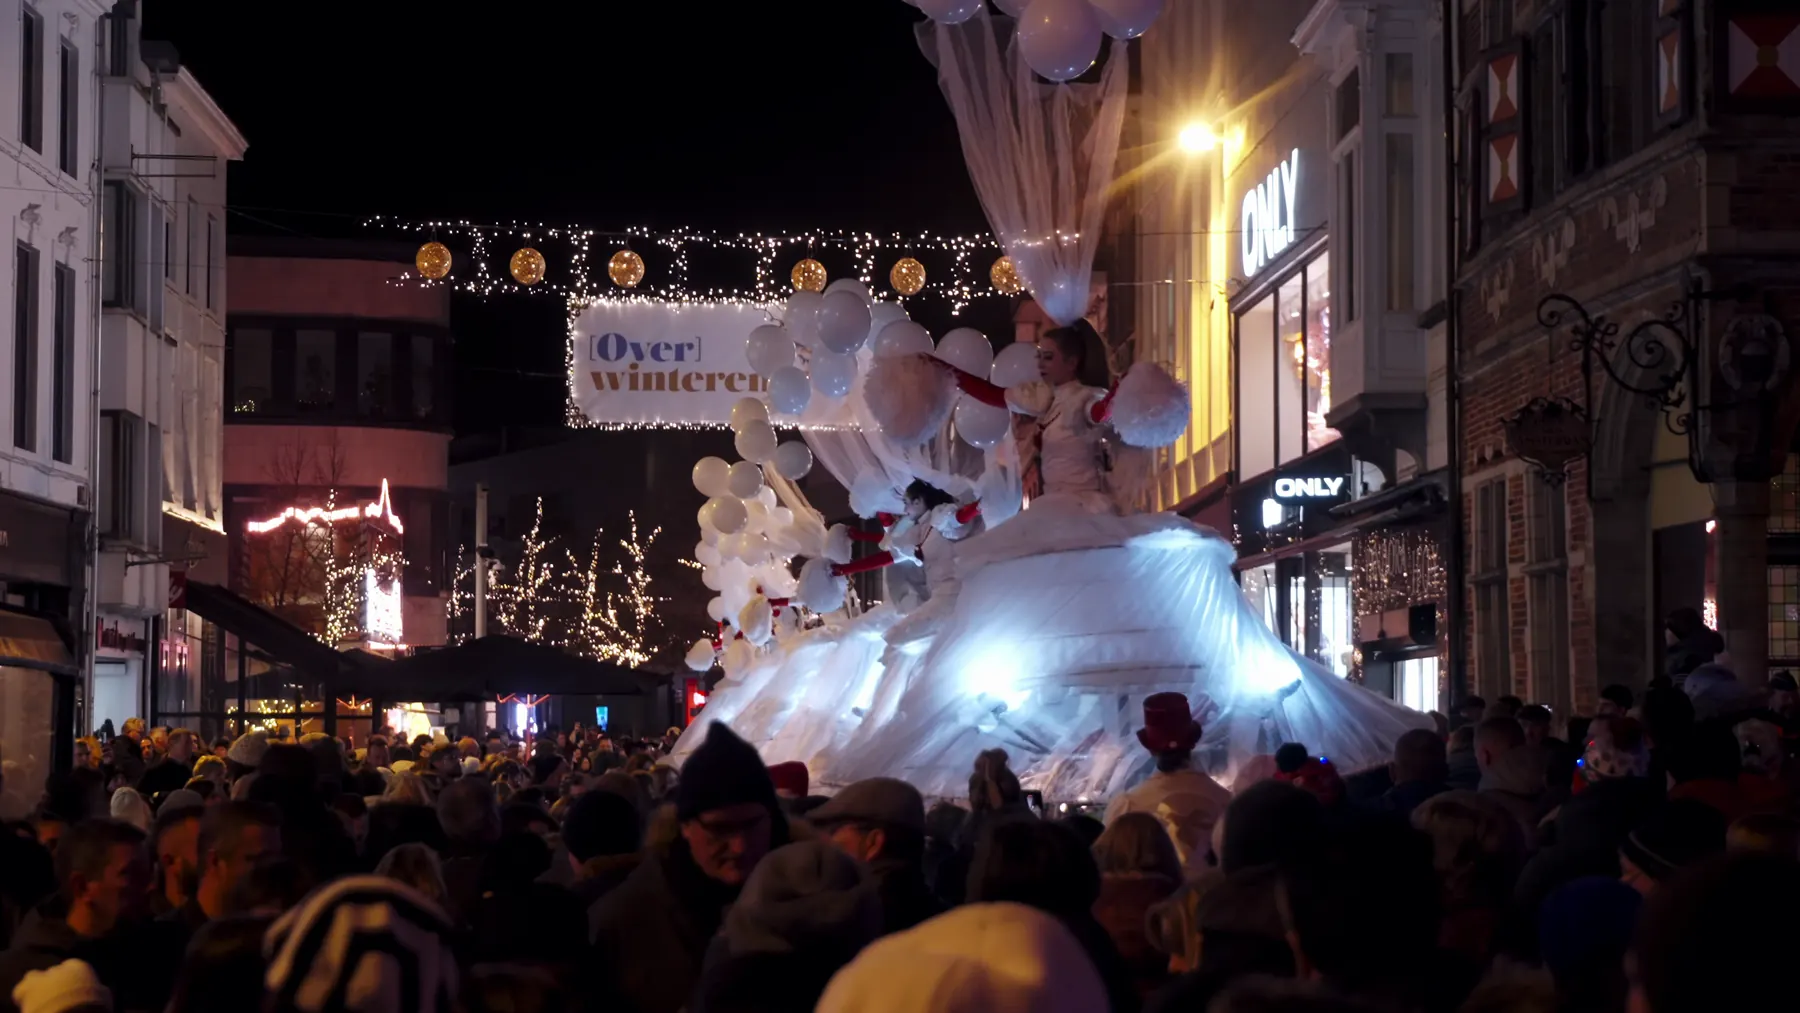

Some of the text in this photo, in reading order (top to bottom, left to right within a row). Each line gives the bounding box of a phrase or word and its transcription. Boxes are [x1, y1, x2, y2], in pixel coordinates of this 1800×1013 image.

[1242, 147, 1299, 277] ONLY
[590, 362, 768, 392] winteren
[1275, 477, 1344, 498] ONLY
